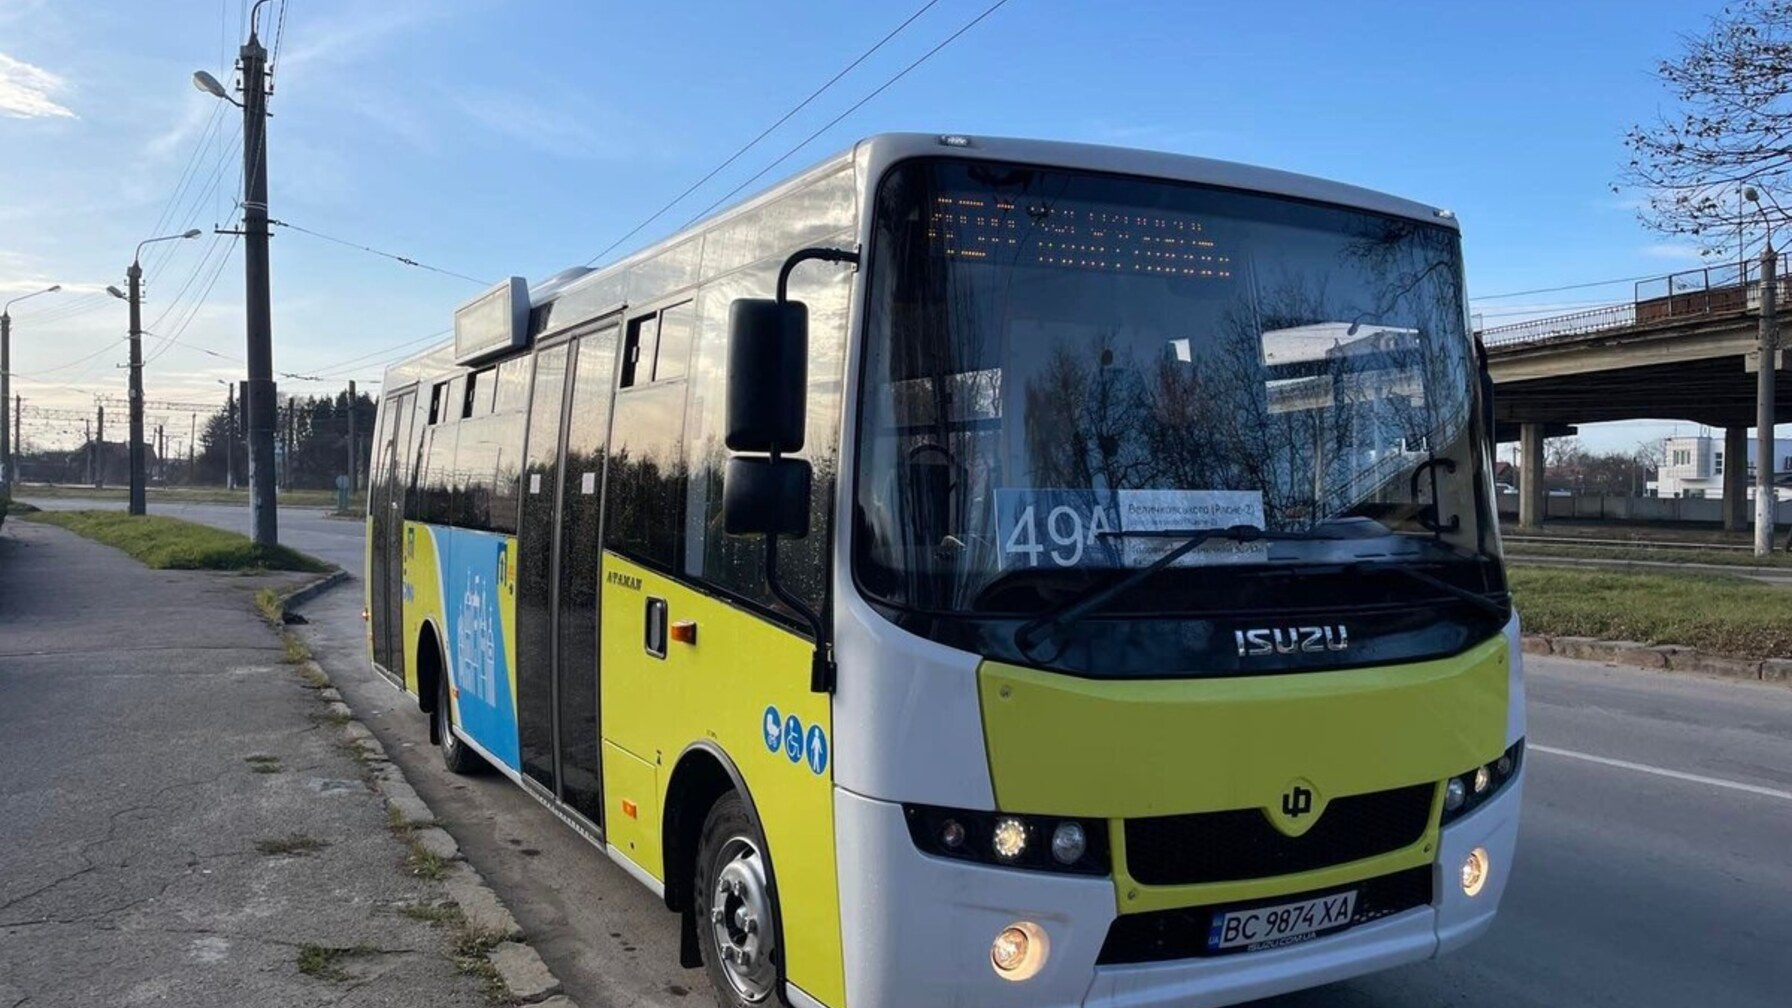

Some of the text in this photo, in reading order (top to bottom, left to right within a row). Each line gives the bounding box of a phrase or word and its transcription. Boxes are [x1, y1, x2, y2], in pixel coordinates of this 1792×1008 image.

[606, 571, 643, 590] ATAMAN
[1234, 625, 1348, 657] ISUZU
[1223, 896, 1348, 943] BC 9874 XA
